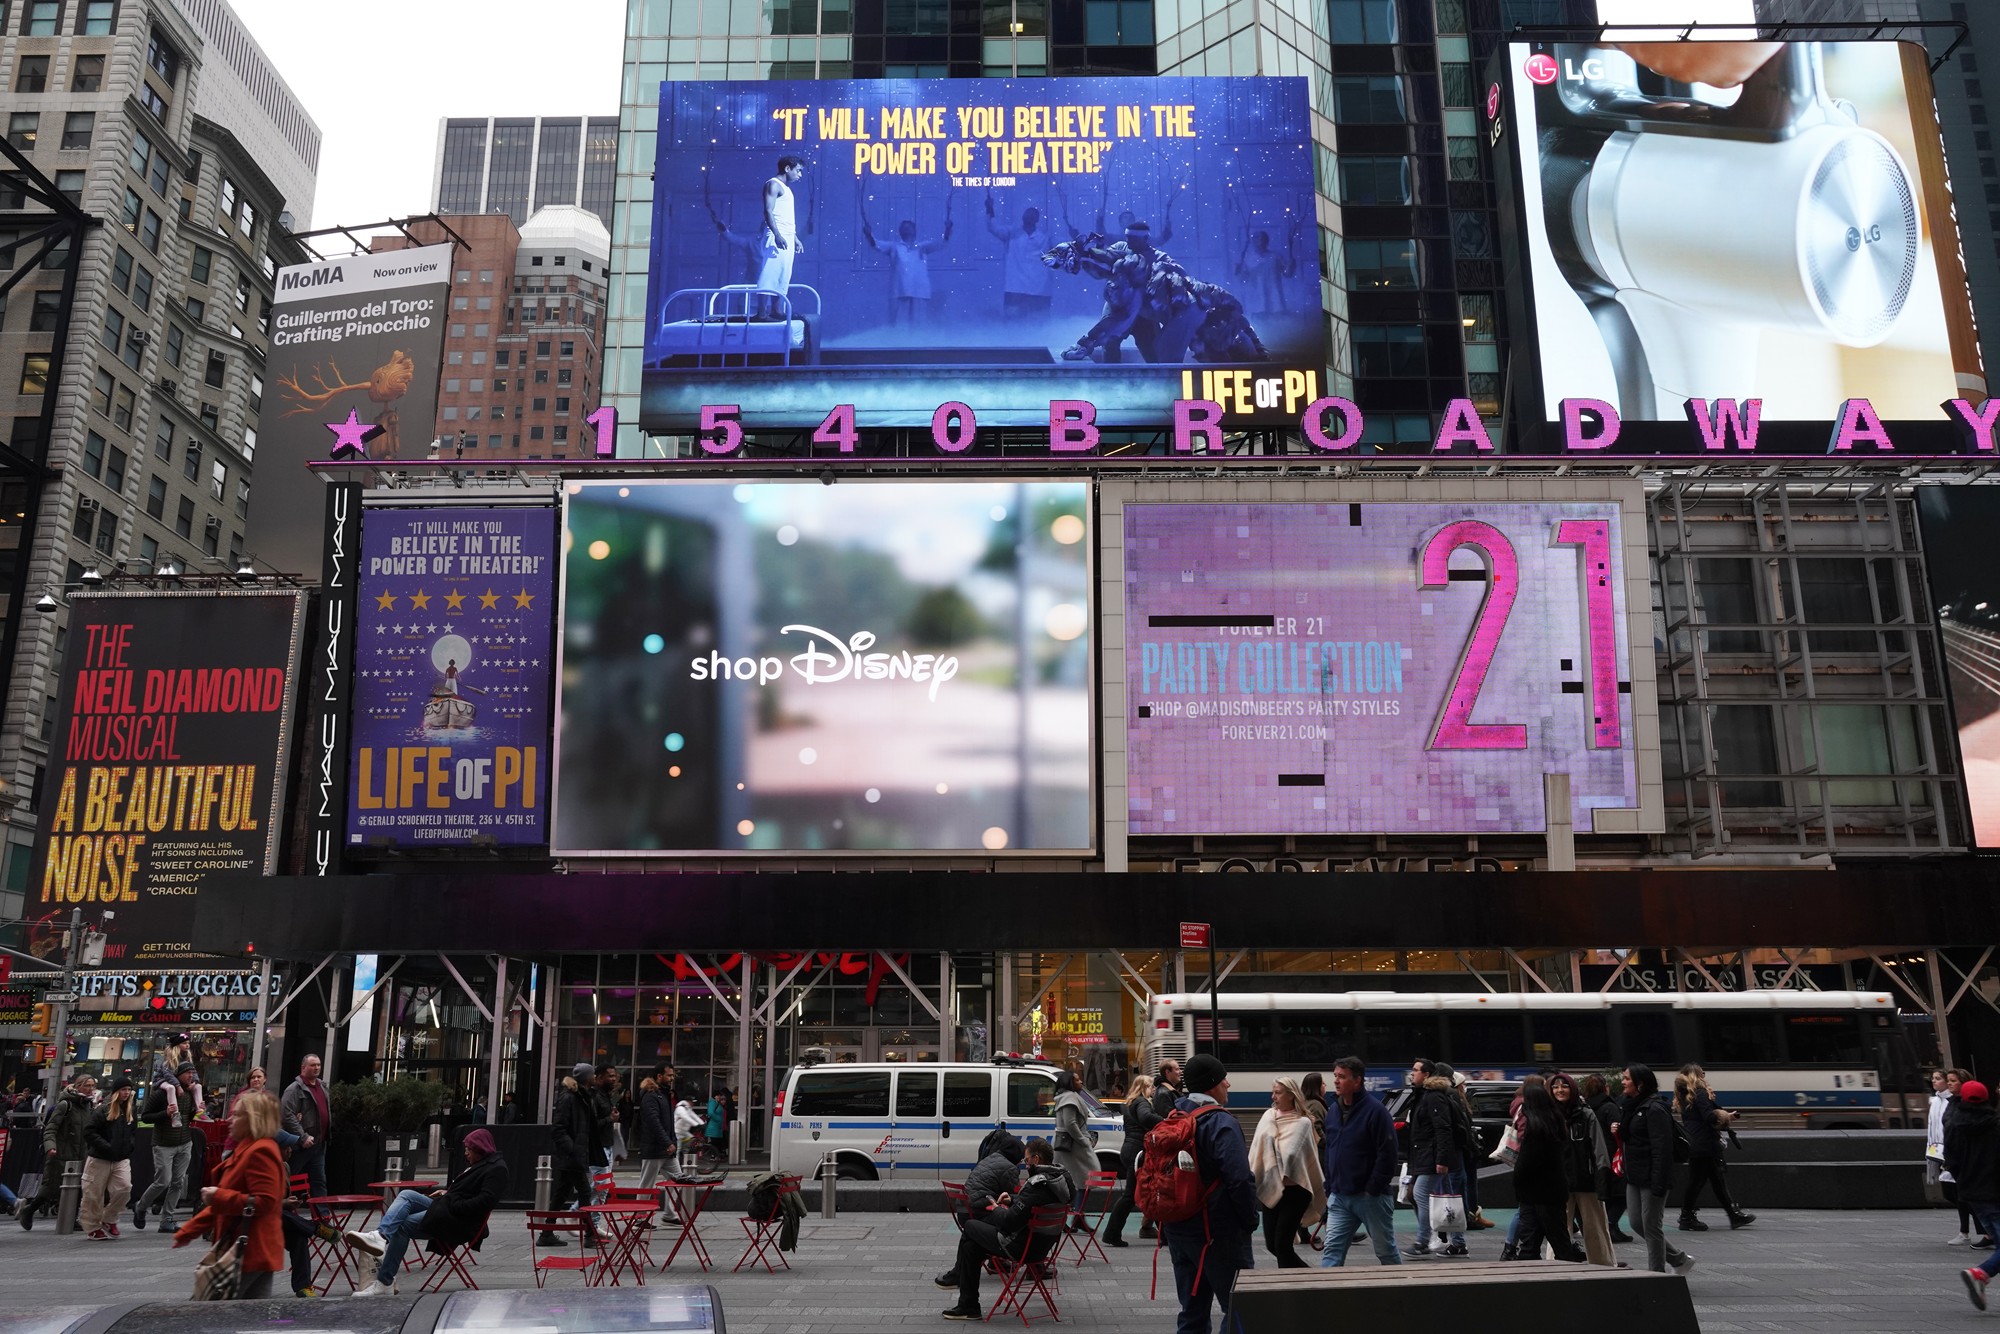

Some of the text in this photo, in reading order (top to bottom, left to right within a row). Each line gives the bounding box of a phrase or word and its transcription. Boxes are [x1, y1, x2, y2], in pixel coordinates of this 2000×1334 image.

[1565, 58, 1604, 81] LG
[772, 105, 1196, 141] “IT WILL MAKE YOU BELIEVE IN THE
[1490, 117, 1501, 148] LG
[855, 141, 1112, 175] POWER OF THEATER!”
[952, 176, 1016, 187] THE TIMES OF LONDON
[1863, 223, 1881, 244] LG
[281, 265, 344, 291] MoMA
[373, 262, 438, 279] Now on view
[276, 299, 434, 329] Guillermo del Toro:
[273, 314, 431, 346] Crafting Pinocchio
[1255, 378, 1283, 409] OF
[1284, 370, 1318, 414] PI
[407, 521, 502, 535] “IT WILL MAKE YOU
[391, 535, 521, 555] BELIEVE IN THE
[371, 556, 545, 576] POWER OF THEATER!”
[1306, 617, 1324, 636] 21
[1417, 520, 1622, 751] 21
[85, 624, 134, 668] THE
[690, 649, 783, 686] shop
[1141, 641, 1404, 694] PARTY COLLECTION
[73, 667, 284, 715] NEIL DIAMOND
[1147, 700, 1400, 719] SHOP @MADISONBEER'S PARTY STYLES
[65, 715, 182, 761] MUSICAL
[1222, 725, 1327, 740] FOREVER21.COM
[358, 746, 537, 810] LIFE OF PI
[51, 765, 258, 833] A BEAUTIFUL
[368, 814, 536, 826] GERALD SCHOENFELD THEATRE, 236 W. 45TH ST.
[414, 828, 479, 839] LIFEOFPIBWAY.COM
[152, 842, 199, 850] FEATURING
[218, 841, 232, 849] HIS
[197, 849, 244, 857] INCLUDING
[40, 833, 146, 903] NOISE
[150, 860, 254, 870] "SWEET CAROLINE"
[142, 943, 163, 951] GET
[158, 974, 282, 997] LUGGAGE
[167, 997, 195, 1010] NY
[71, 1014, 93, 1023] Apple
[100, 1012, 132, 1022] Nikon
[139, 1011, 182, 1022] Canon
[190, 1012, 234, 1021] SONY
